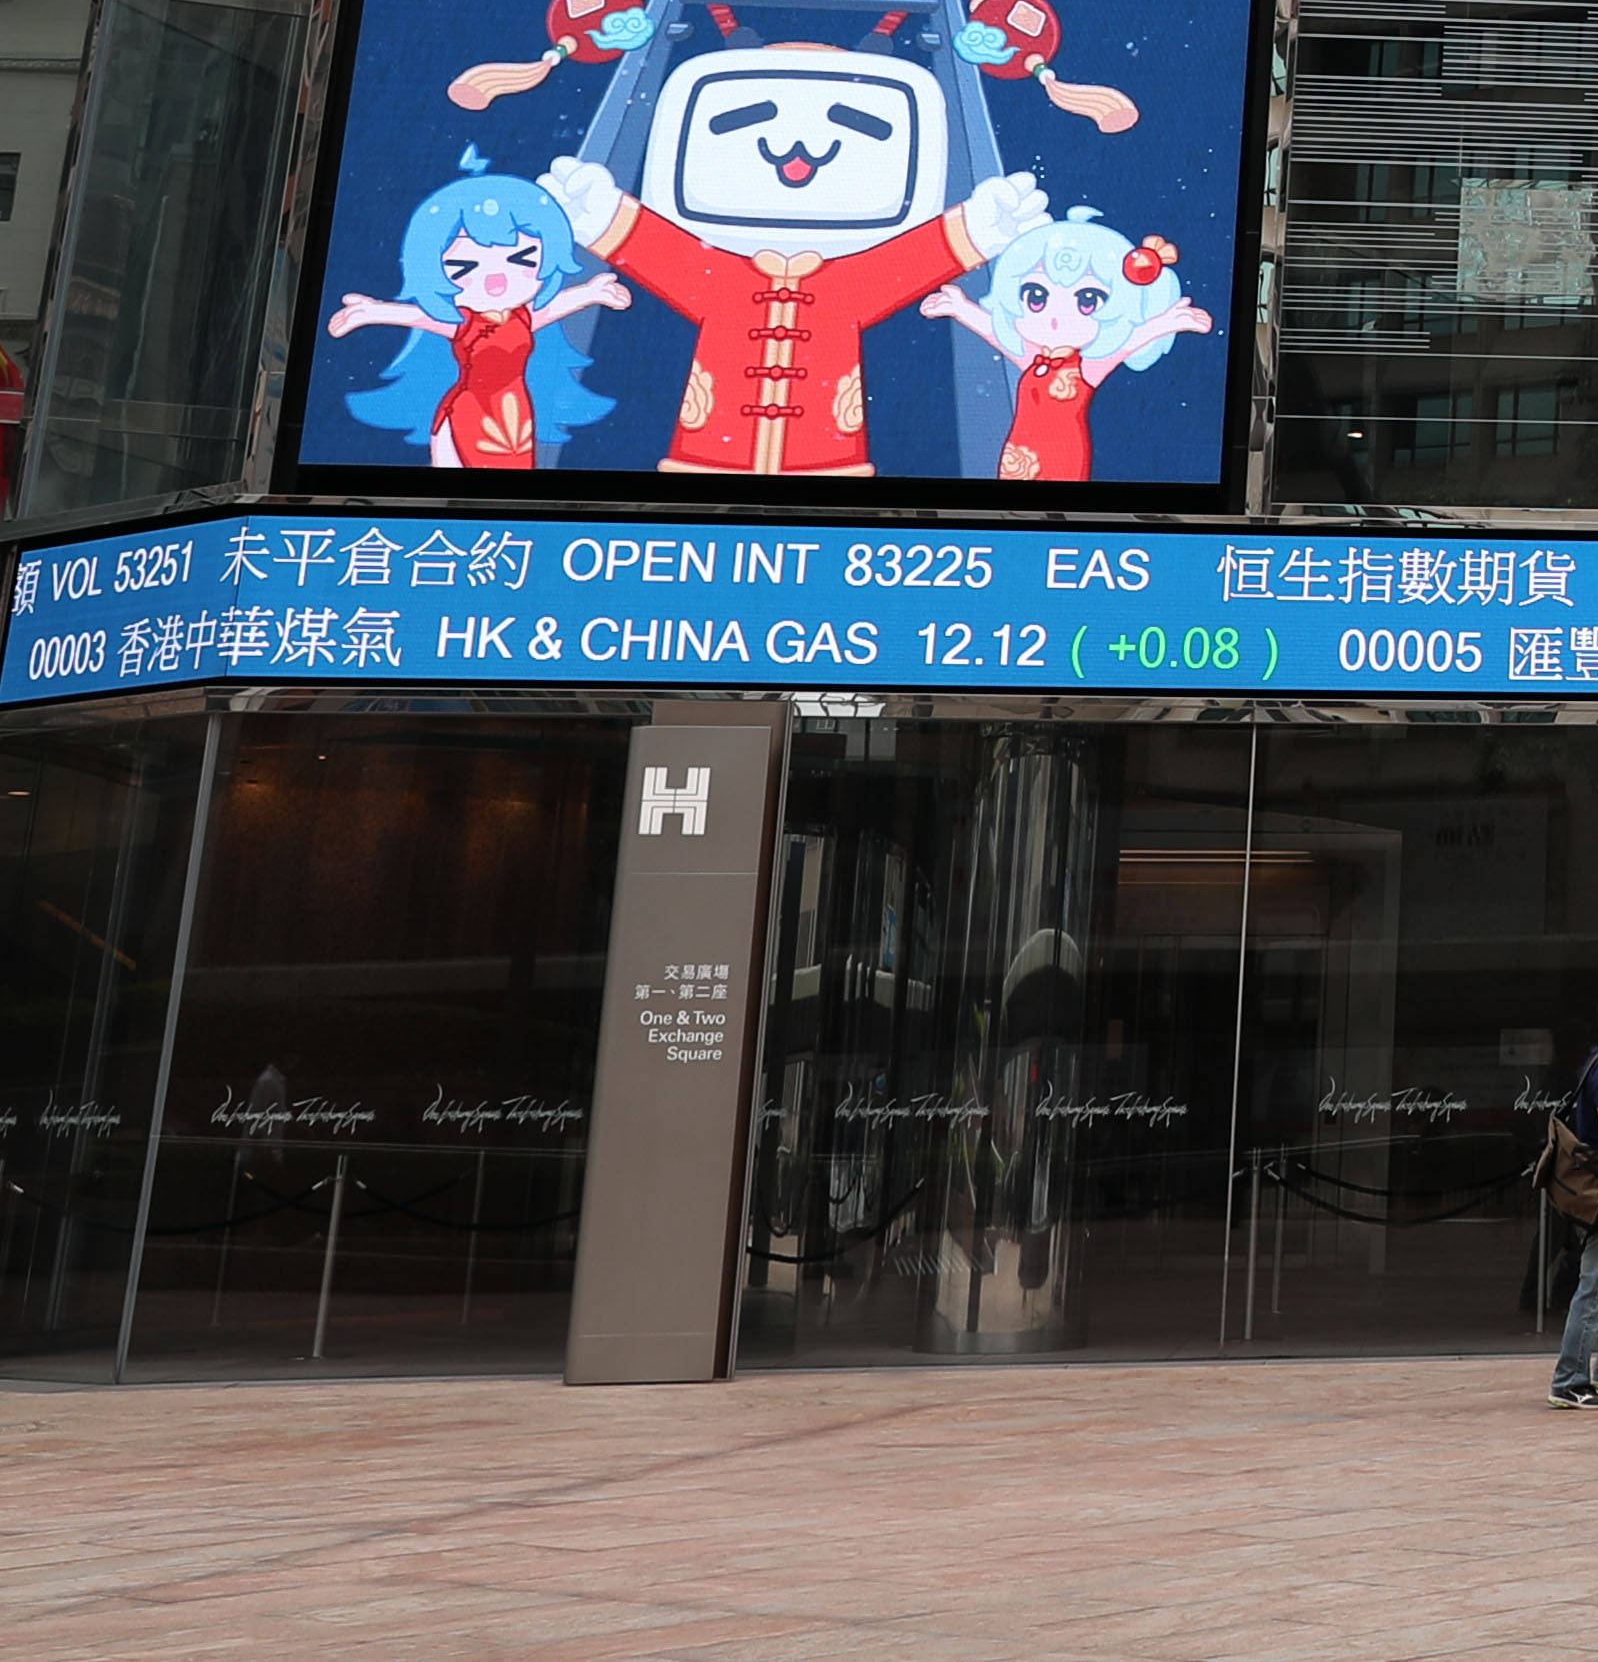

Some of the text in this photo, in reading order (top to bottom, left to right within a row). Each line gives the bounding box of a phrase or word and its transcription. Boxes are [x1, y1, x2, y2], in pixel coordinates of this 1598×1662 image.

[53, 557, 101, 600] VOL
[114, 541, 192, 592] 53251
[221, 527, 533, 589] 未平倉合約
[563, 539, 715, 582] OPEN
[733, 543, 820, 583] INT
[845, 544, 992, 588] 83225
[1047, 549, 1149, 590] EAS
[1217, 545, 1576, 606] 恒生指數期貨
[30, 631, 106, 680] 00003
[118, 606, 401, 677] 香港中華煤氣
[438, 617, 515, 658] HK
[529, 617, 562, 660] &
[581, 618, 749, 661] CHINA
[767, 621, 878, 664] GAS
[919, 623, 1046, 666] 12.12
[1340, 629, 1482, 672] 00005
[664, 964, 730, 981] 交易廣場
[640, 1010, 725, 1026] One & Two
[649, 1029, 723, 1044] Exchange
[667, 1044, 722, 1063] Square
